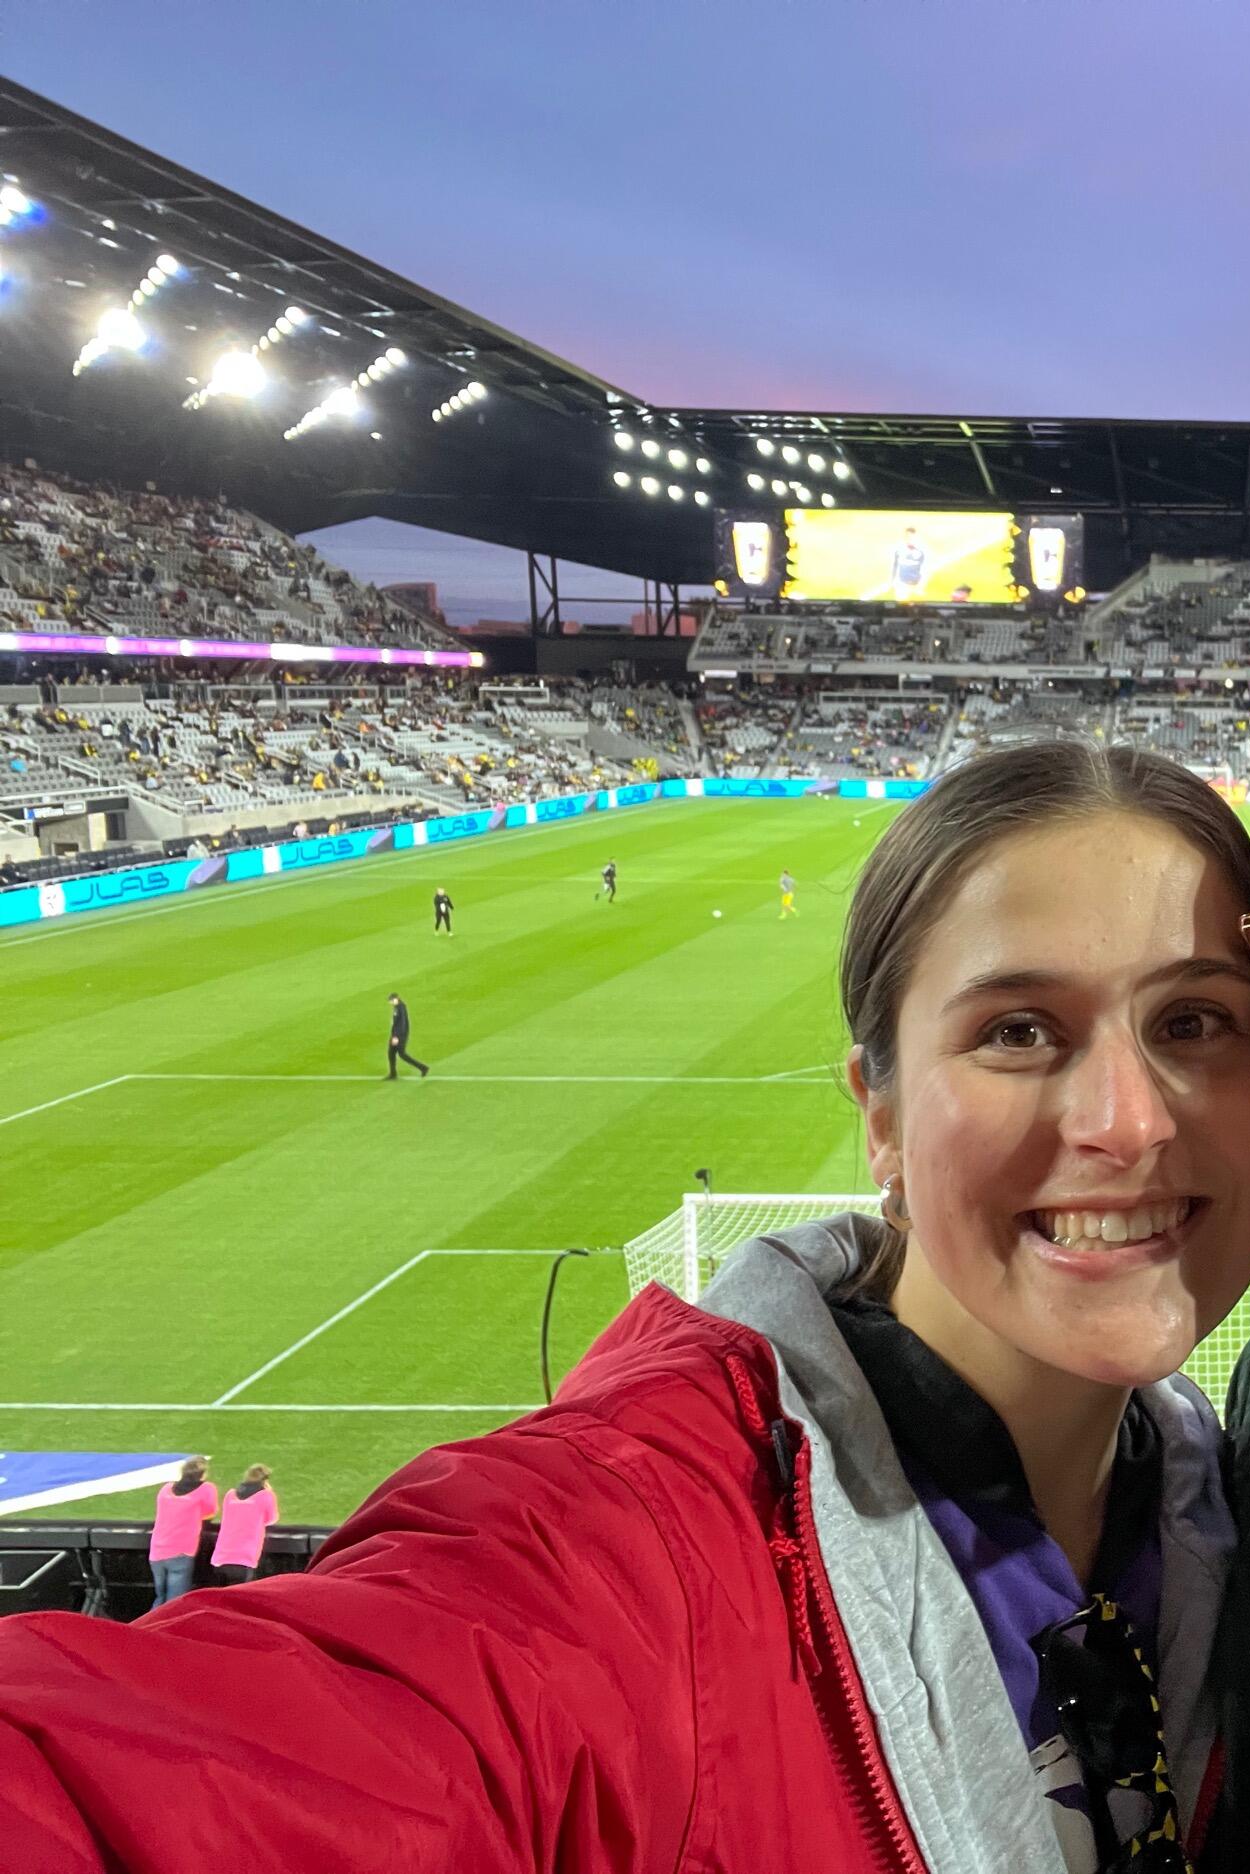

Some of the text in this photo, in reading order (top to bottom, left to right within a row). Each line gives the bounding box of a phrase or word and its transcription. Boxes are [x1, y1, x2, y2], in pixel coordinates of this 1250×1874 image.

[429, 817, 479, 839] JLAB
[281, 838, 355, 866] JLAB
[70, 872, 169, 906] JLAB
